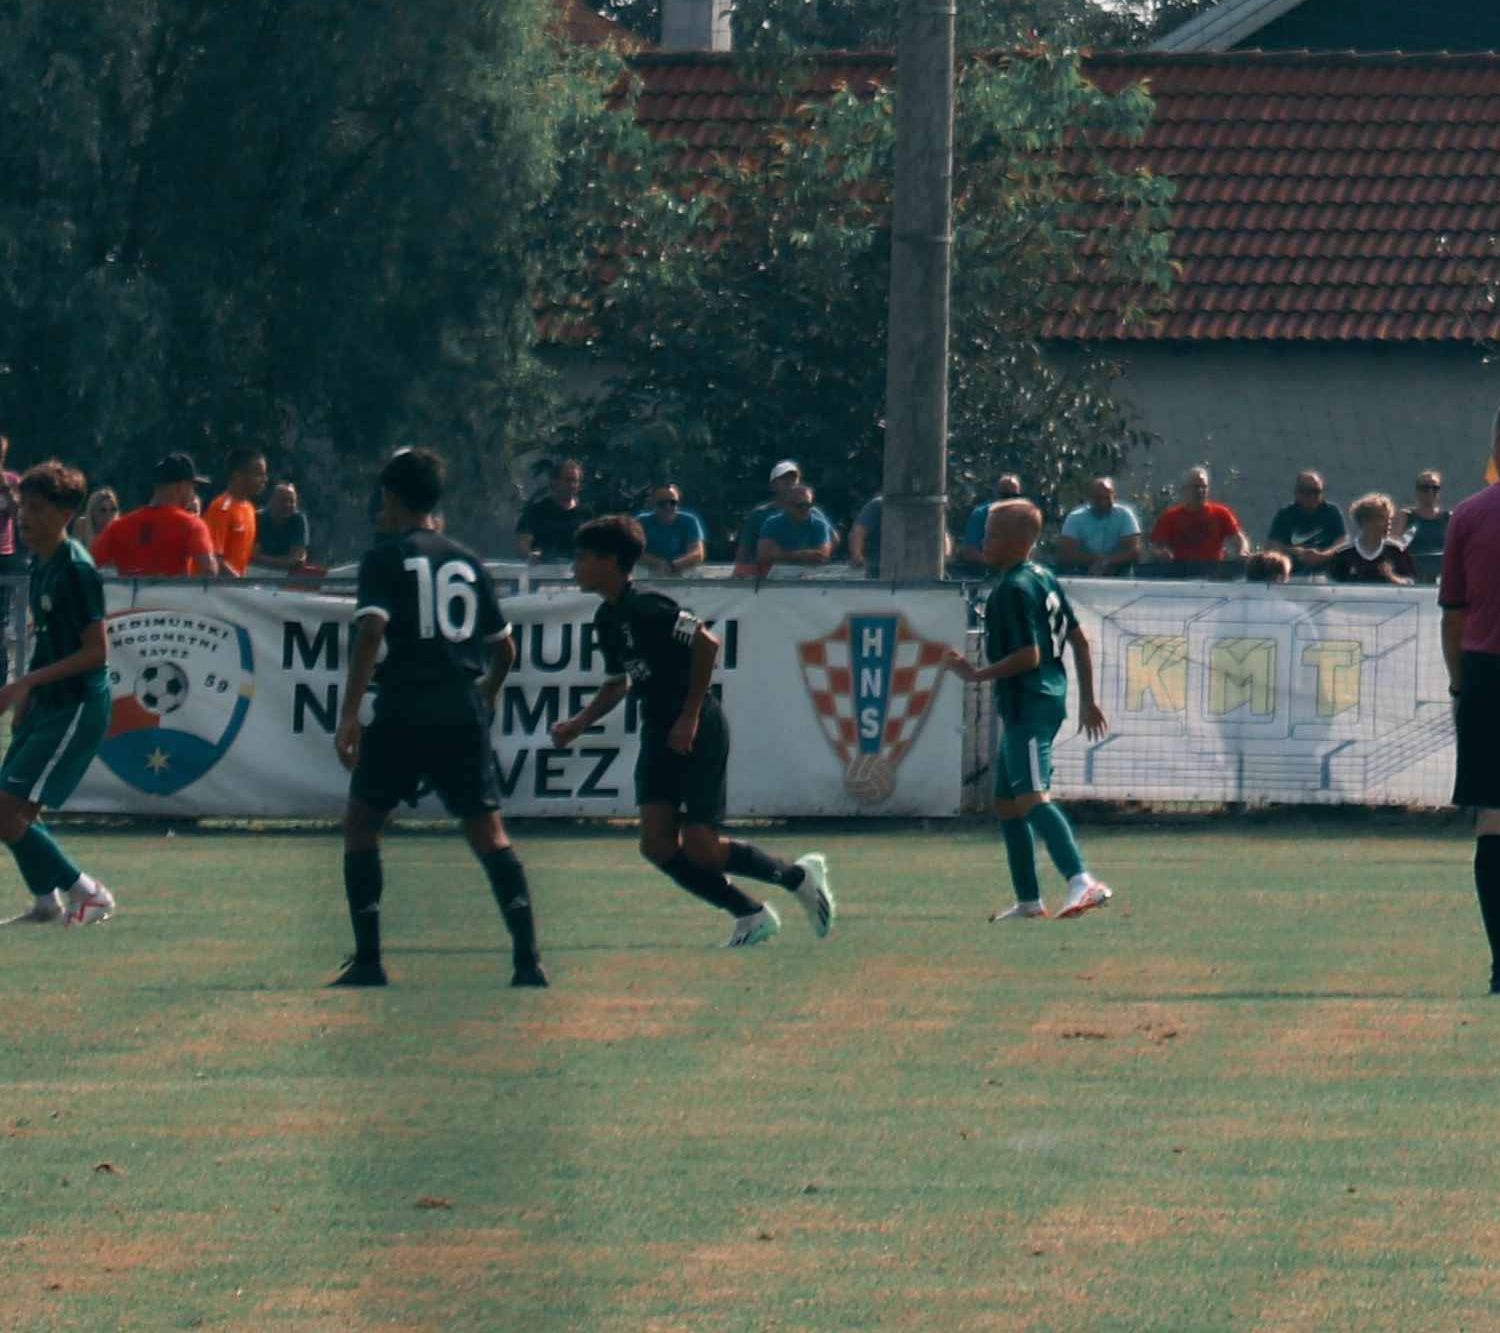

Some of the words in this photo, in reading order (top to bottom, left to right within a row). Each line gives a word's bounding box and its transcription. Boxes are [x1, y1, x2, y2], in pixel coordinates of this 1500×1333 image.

[404, 556, 477, 643] 16
[861, 627, 883, 739] HNS
[1125, 635, 1362, 718] KMT
[494, 747, 620, 798] VEZ
